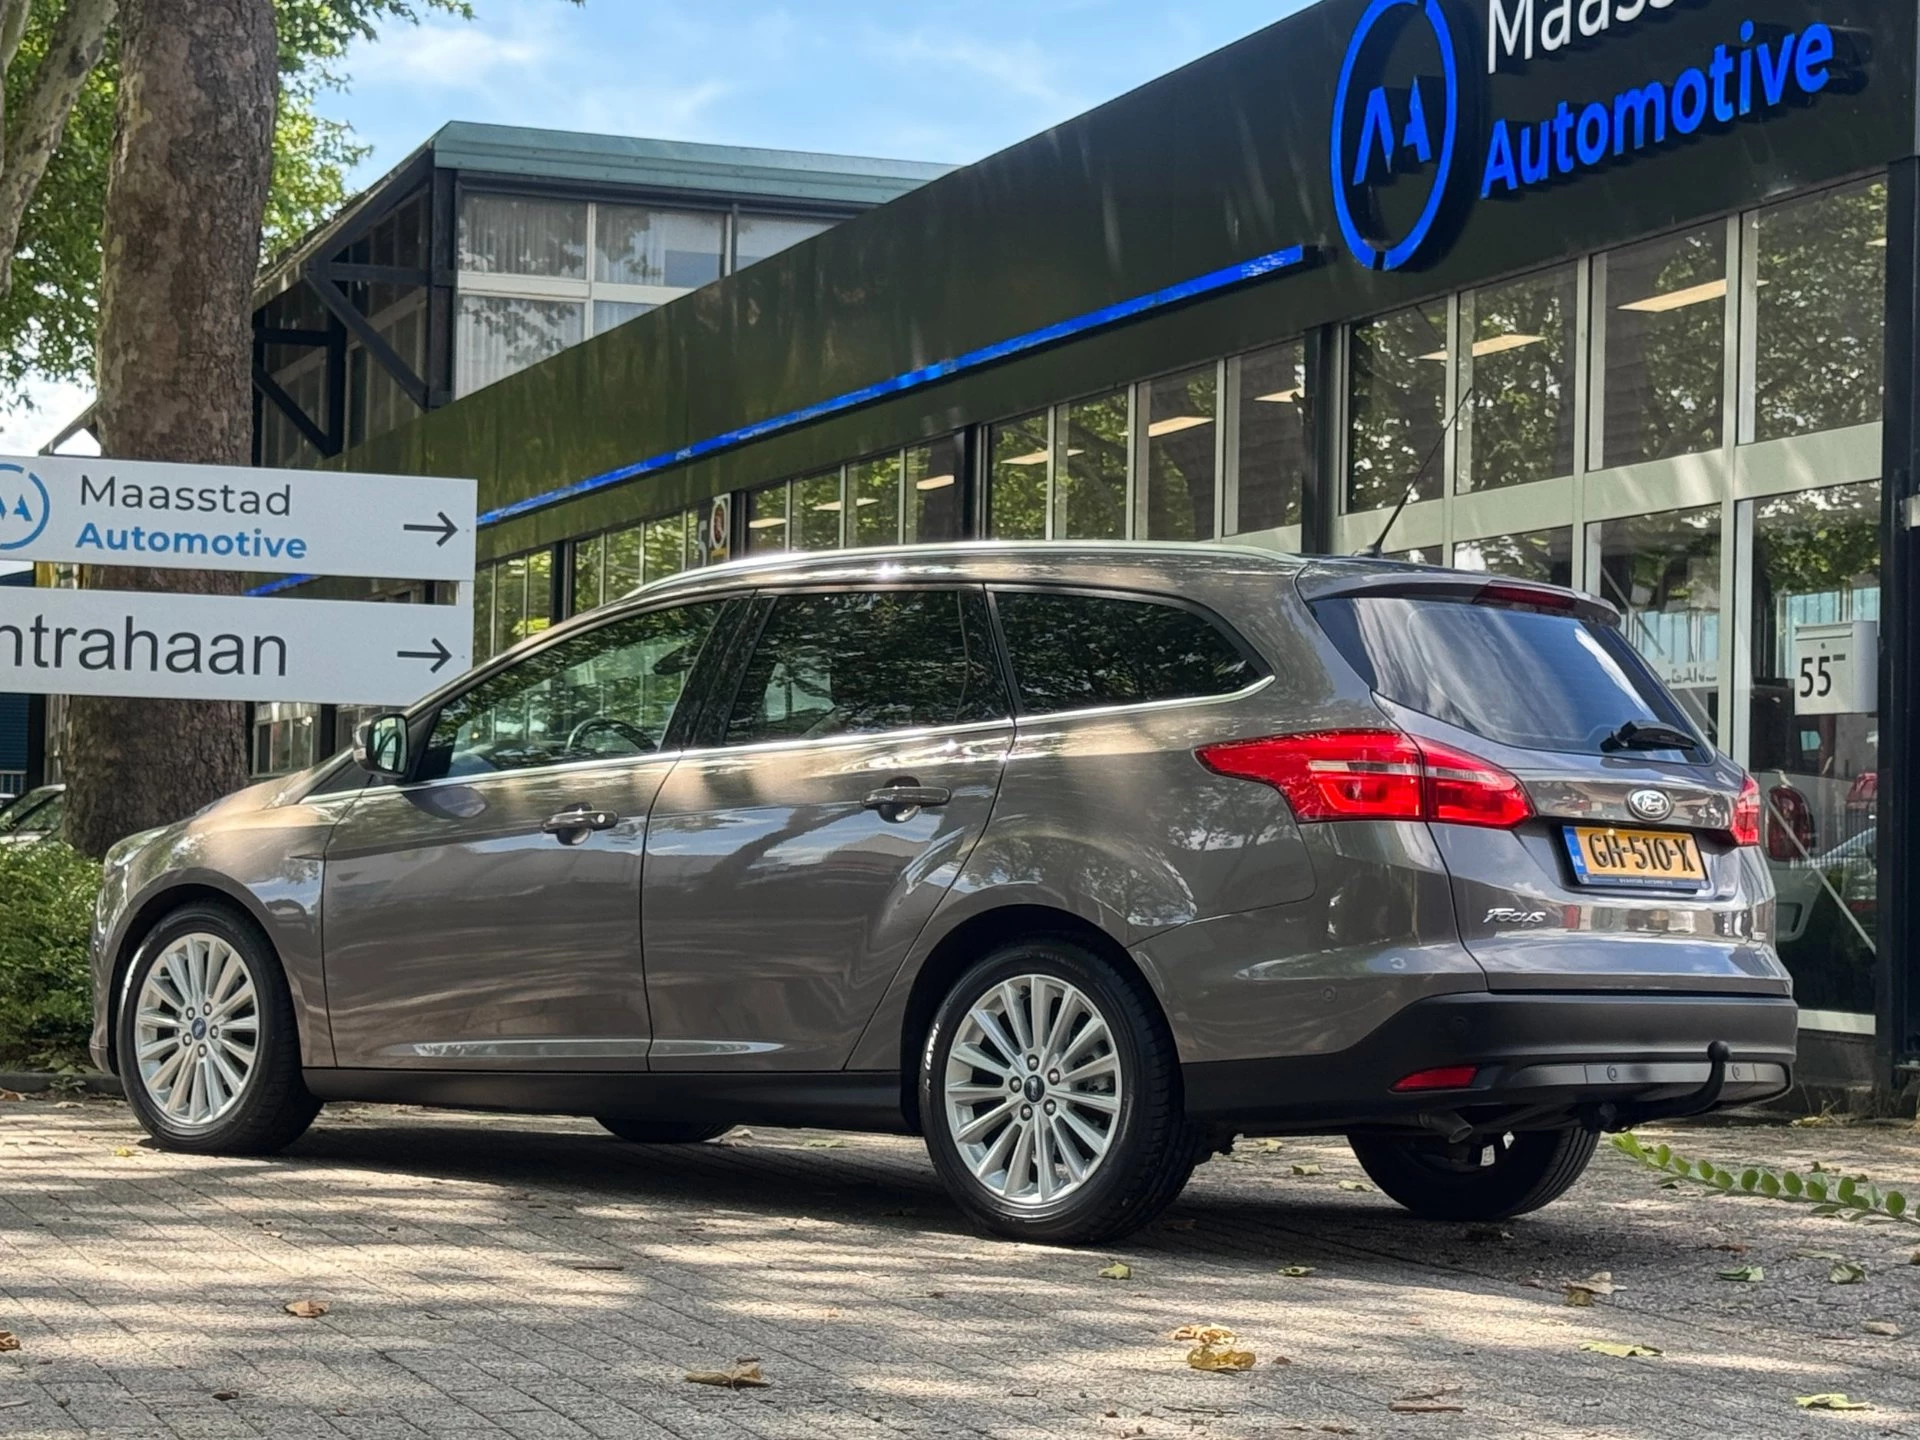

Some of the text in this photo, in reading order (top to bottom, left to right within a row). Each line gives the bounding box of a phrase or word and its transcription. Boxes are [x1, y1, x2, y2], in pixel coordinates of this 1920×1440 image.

[1488, 0, 1674, 74] Maa
[1480, 19, 1834, 199] Automotive
[80, 474, 291, 516] Maasstad
[75, 522, 308, 559] Automotive
[0, 613, 288, 677] ntrahaan
[1800, 655, 1832, 698] 55
[1588, 832, 1696, 873] GH-510-X
